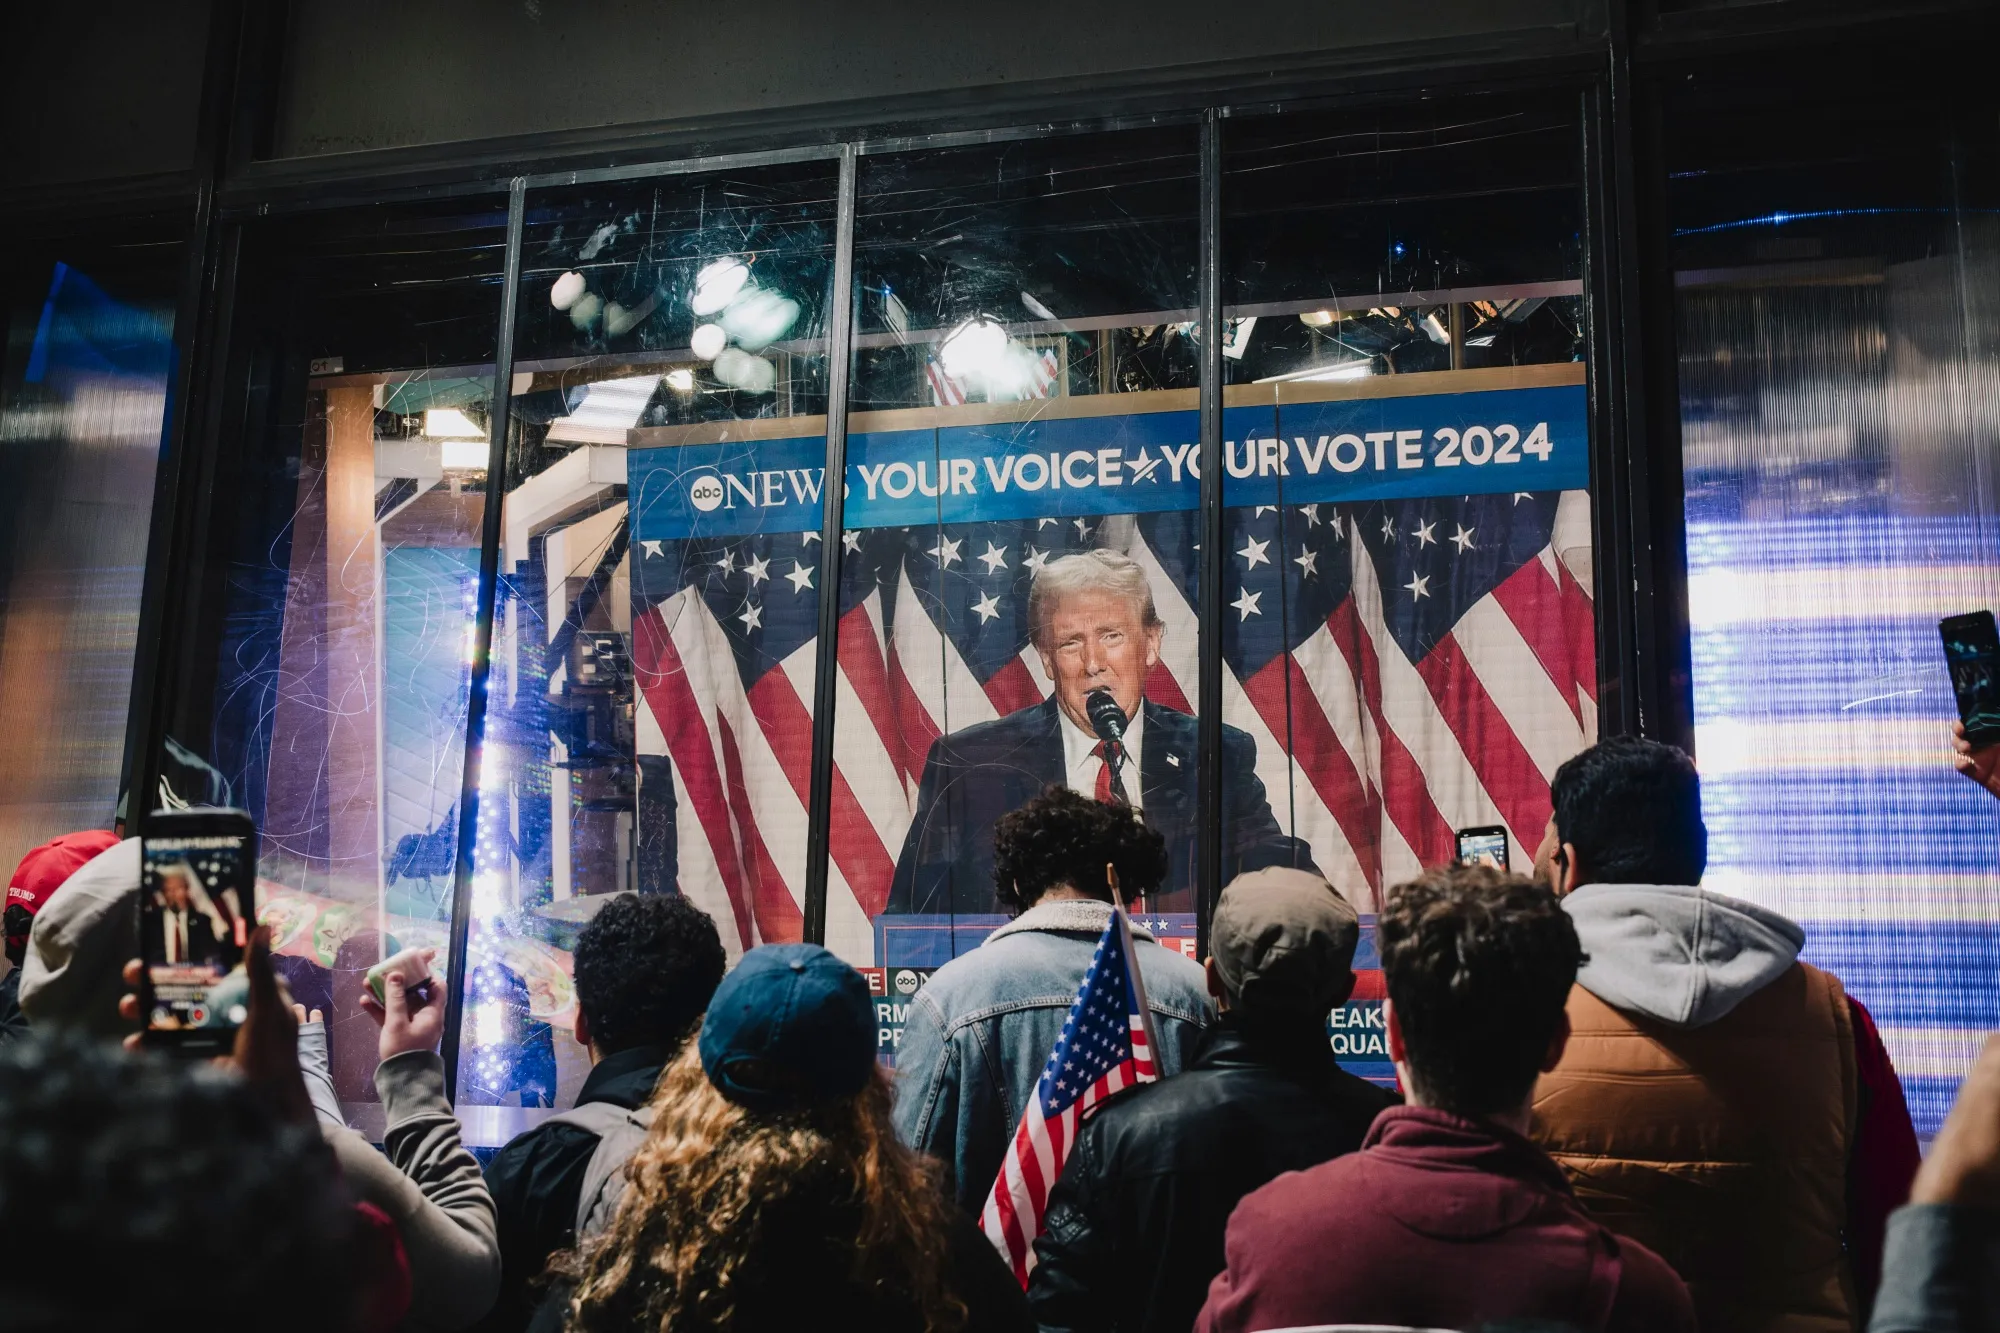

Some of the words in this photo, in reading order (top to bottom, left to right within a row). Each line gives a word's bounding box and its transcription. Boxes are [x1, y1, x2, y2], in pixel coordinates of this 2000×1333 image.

[721, 466, 850, 509] NEW
[857, 458, 977, 501] YOUR
[984, 448, 1123, 493] VOICE
[1294, 429, 1424, 475] VOTE
[1433, 422, 1554, 468] 2024
[9, 887, 36, 902] TRUMP
[1328, 1007, 1387, 1029] EAK
